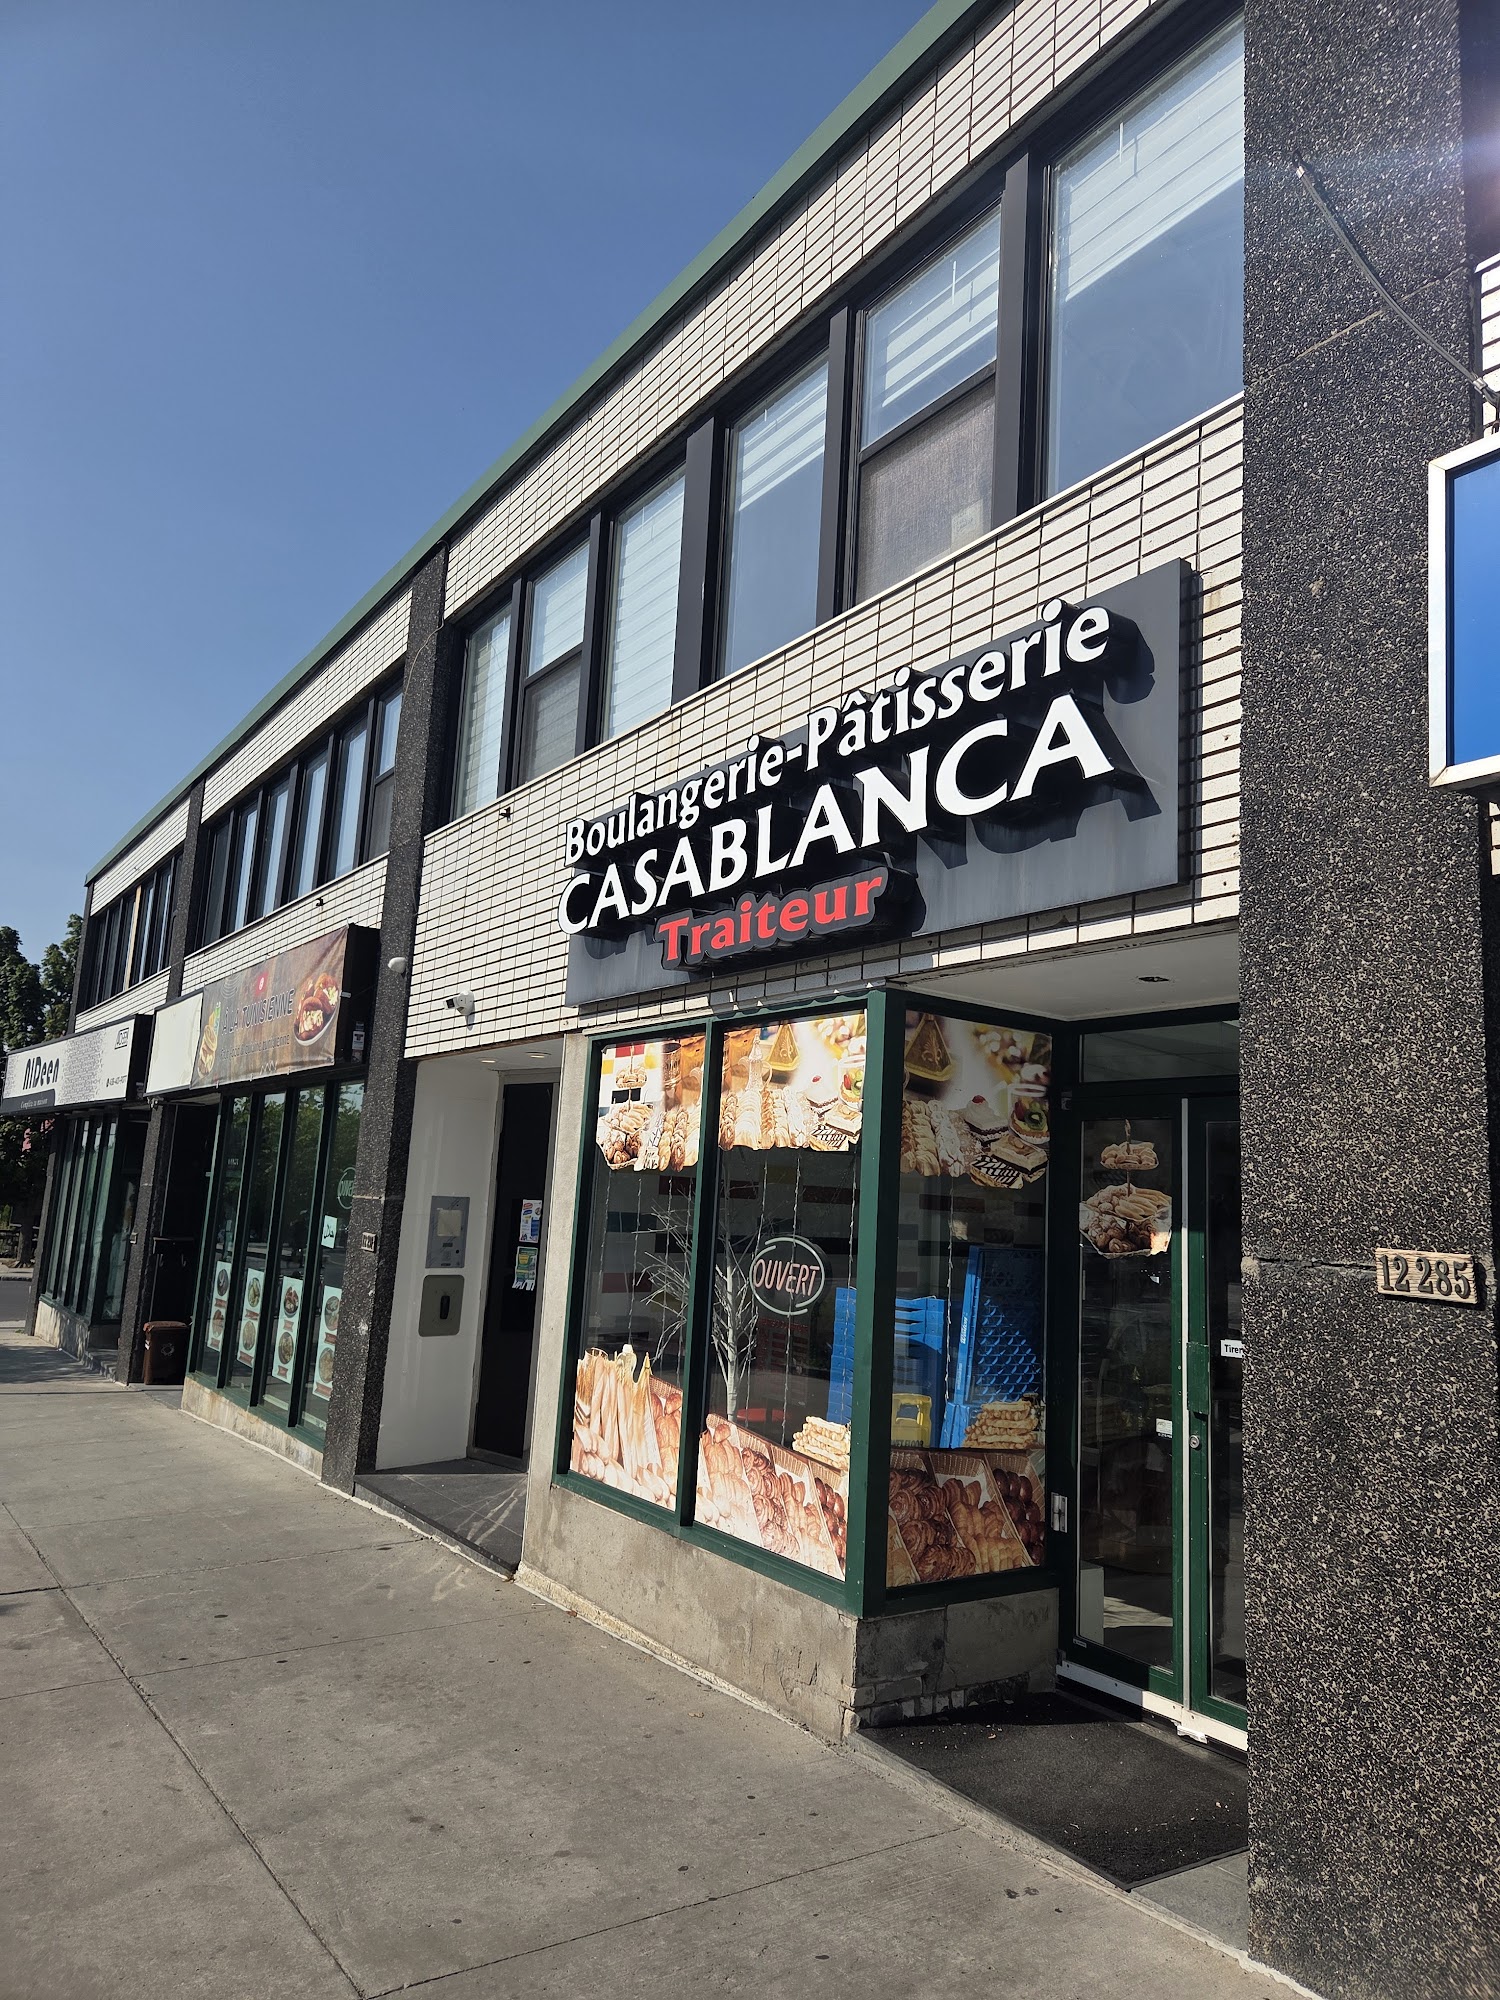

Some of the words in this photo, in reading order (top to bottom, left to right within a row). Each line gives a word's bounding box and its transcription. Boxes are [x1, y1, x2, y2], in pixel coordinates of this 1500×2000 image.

[564, 598, 1111, 867] Boulangerie-Pâtisserie
[557, 694, 1116, 936] CASABLANCA
[657, 873, 884, 964] Traiteur
[242, 988, 296, 1029] TUNISIENNE
[753, 1258, 820, 1297] OUVERT
